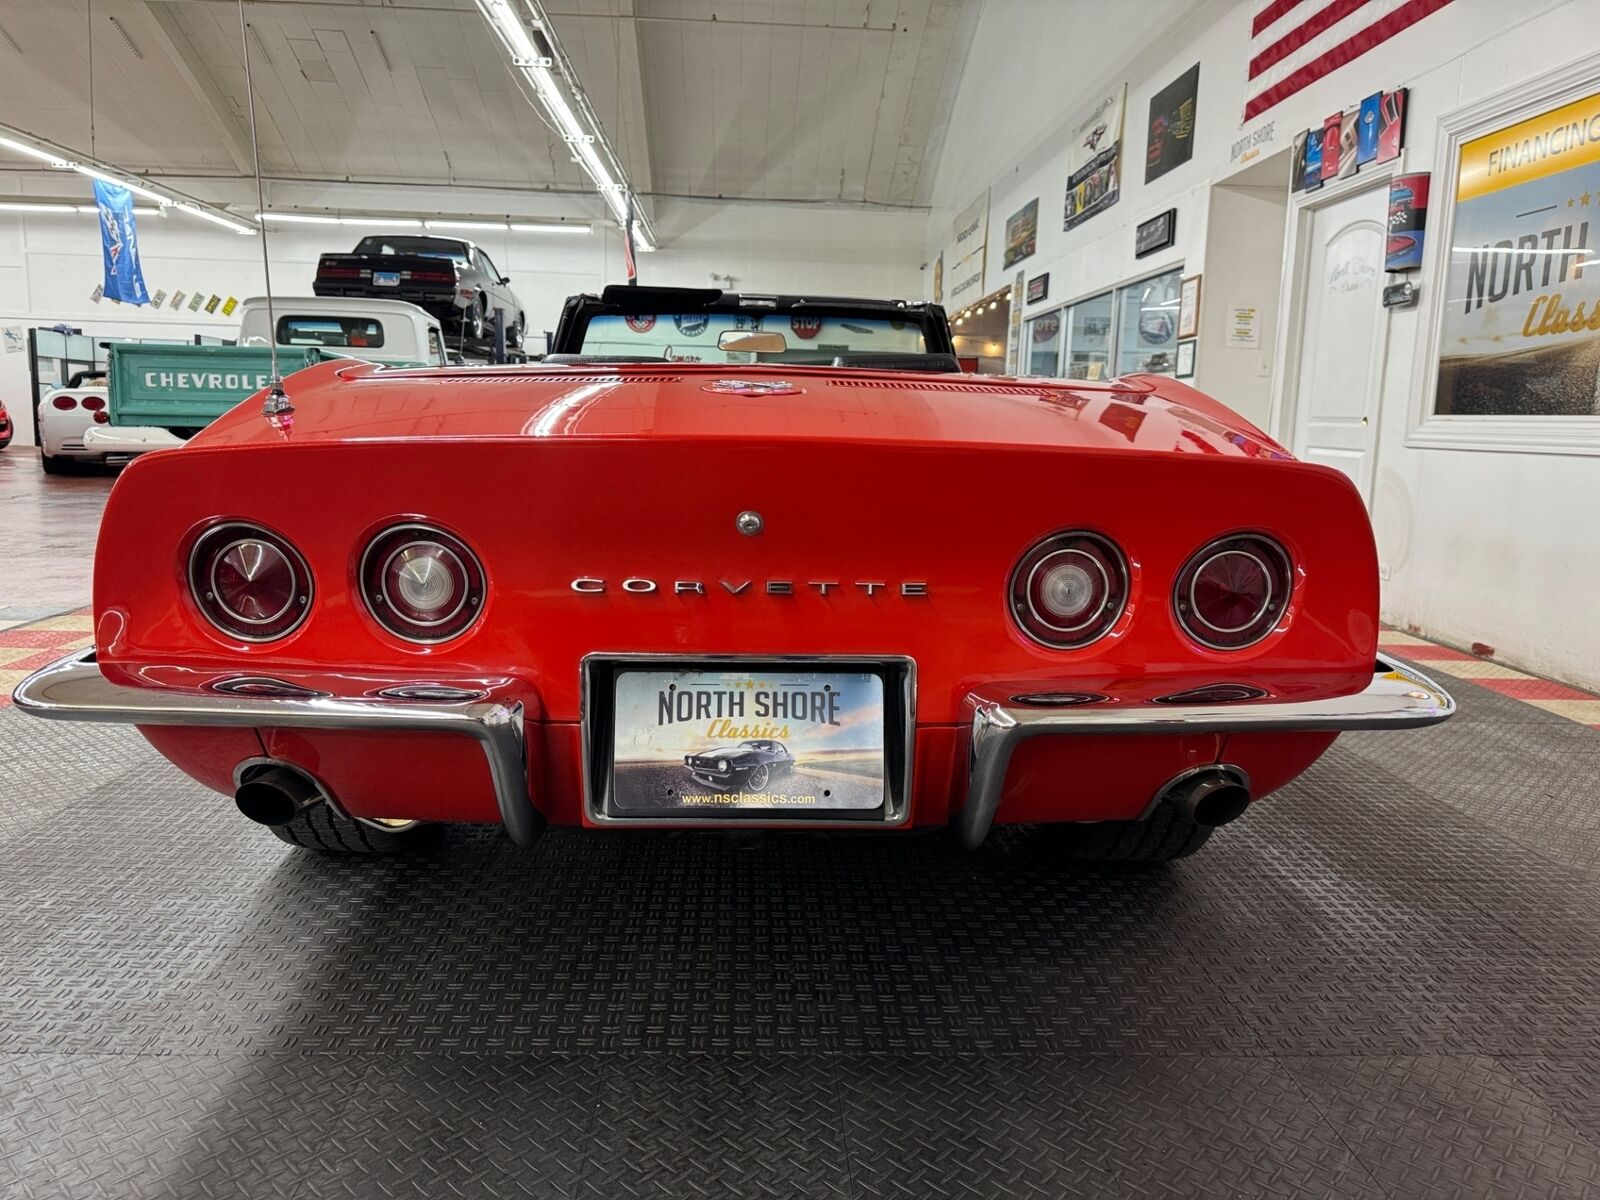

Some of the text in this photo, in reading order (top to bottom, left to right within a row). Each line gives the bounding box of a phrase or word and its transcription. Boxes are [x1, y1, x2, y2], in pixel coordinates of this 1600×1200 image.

[1465, 221, 1589, 315] NORTH
[792, 316, 821, 330] STOP
[570, 576, 928, 596] CORVETTE
[658, 690, 841, 727] NORTH SHORE
[706, 719, 792, 740] Classics
[681, 792, 817, 806] www.nsclassics.com
